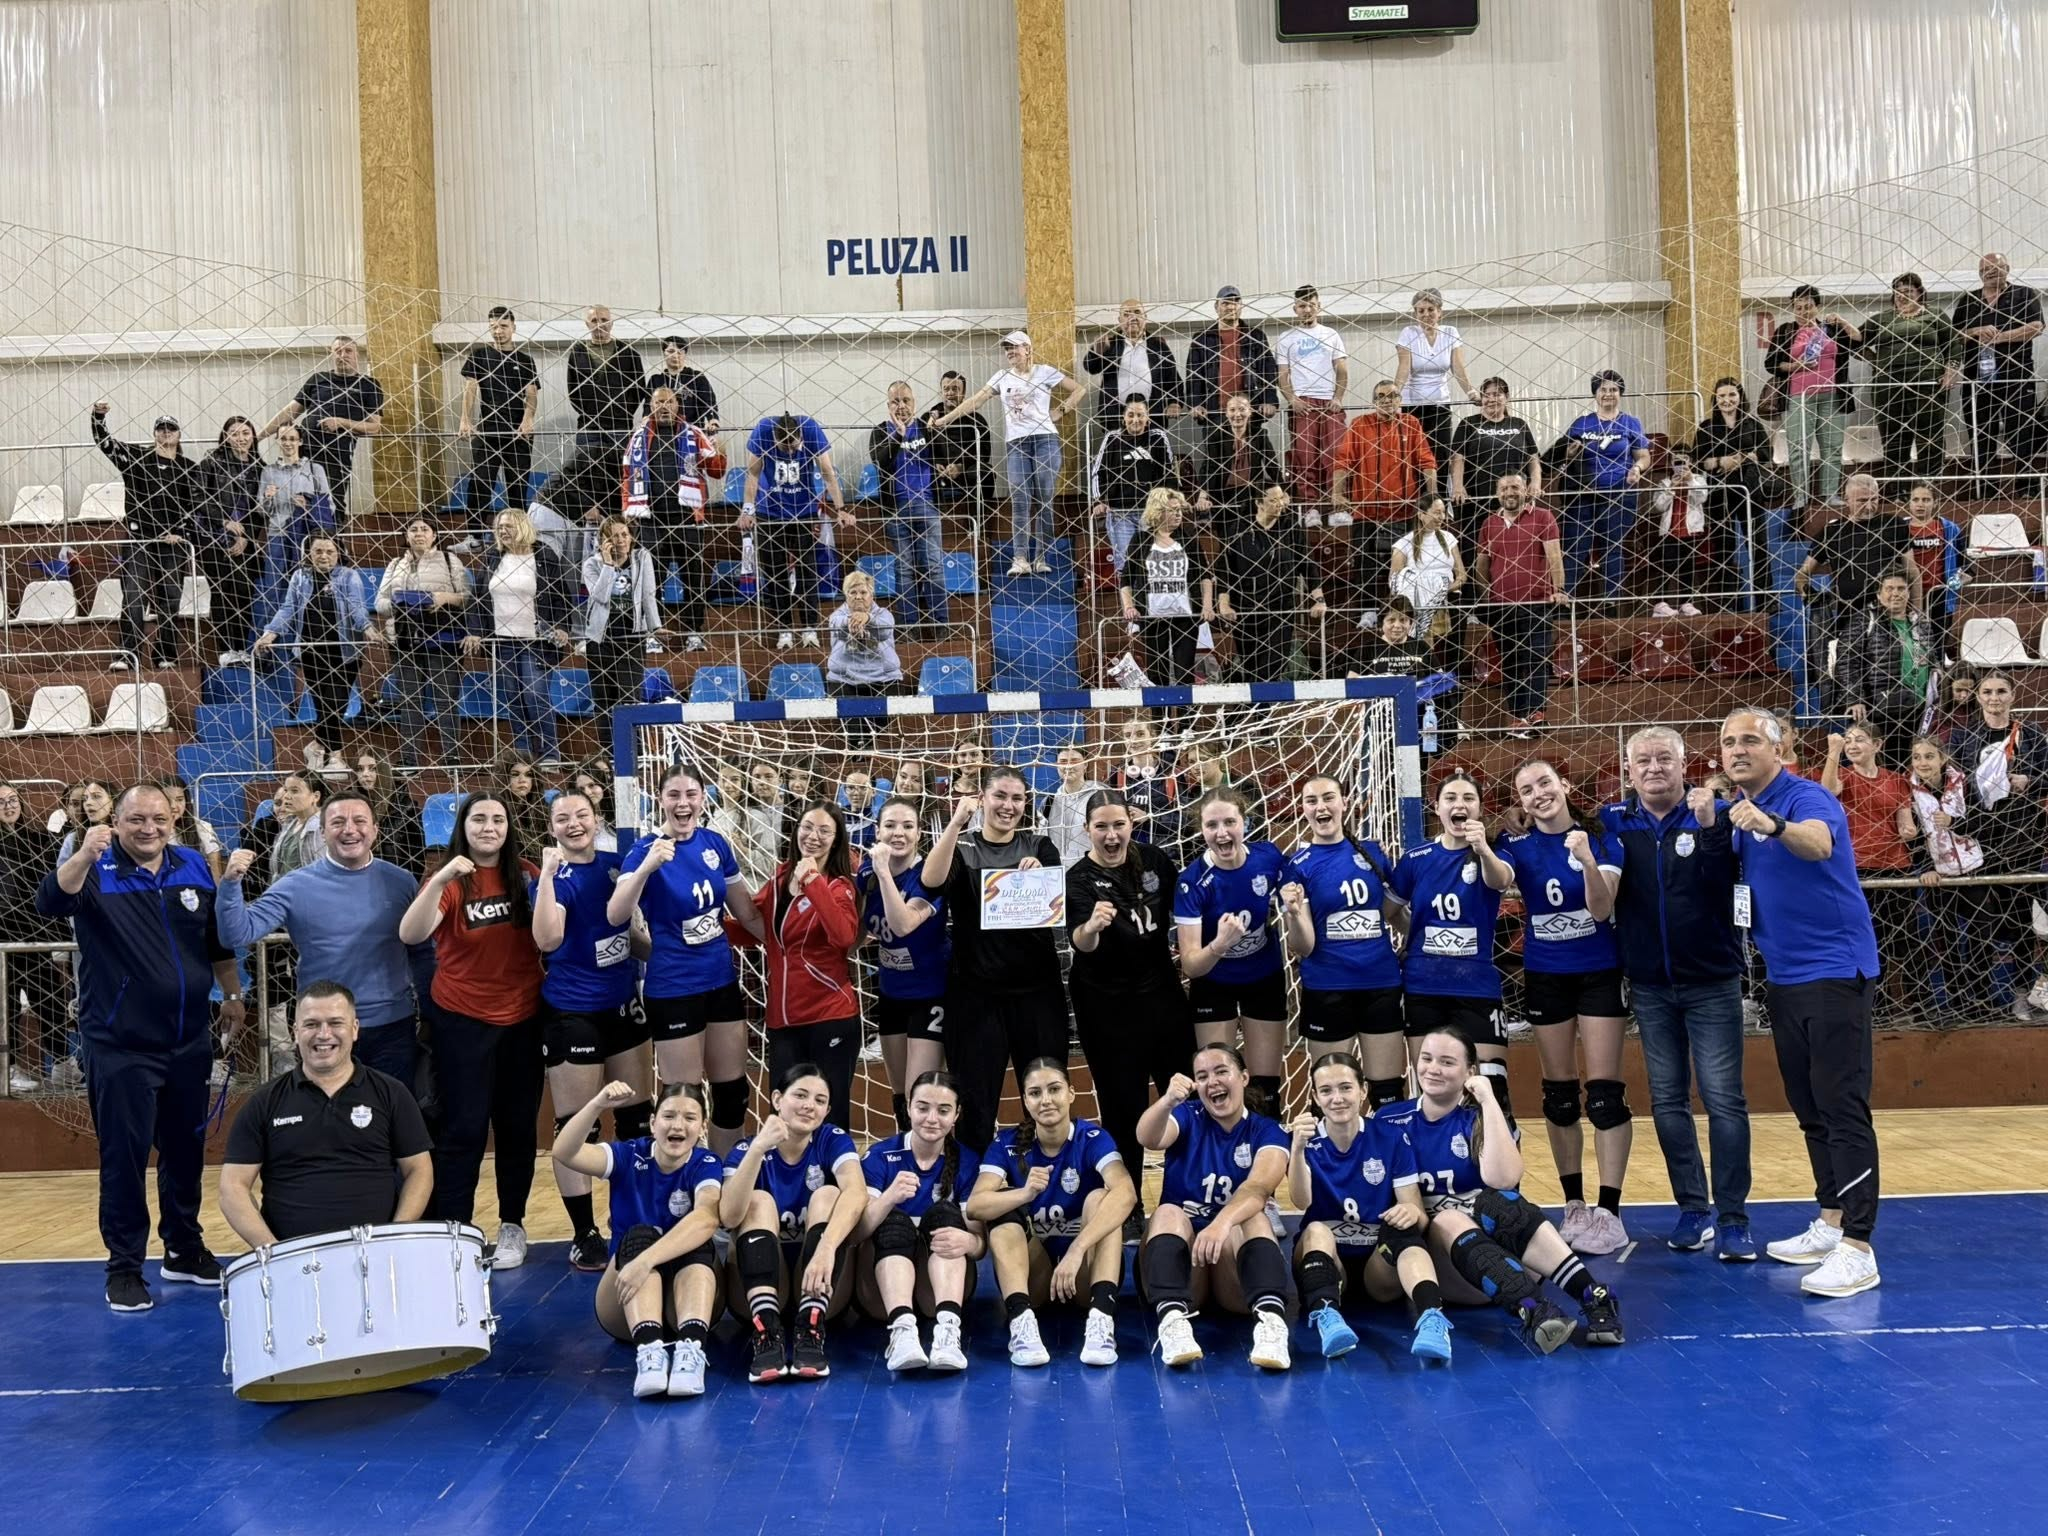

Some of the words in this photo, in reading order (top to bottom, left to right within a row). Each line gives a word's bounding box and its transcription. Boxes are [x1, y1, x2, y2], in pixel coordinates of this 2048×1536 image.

[1351, 8, 1406, 18] STRAMATEL
[826, 236, 940, 276] PELUZA
[949, 235, 969, 273] II
[1476, 427, 1522, 437] adidas
[1146, 559, 1186, 578] BSB
[1409, 847, 1433, 859] Kempa
[692, 879, 715, 910] 11
[1001, 887, 1048, 899] DIPLOMA
[1339, 878, 1369, 907] 10
[1546, 878, 1564, 907] 6
[1130, 904, 1158, 935] 12
[1431, 893, 1461, 921] 19
[869, 914, 894, 943] 28
[570, 1046, 596, 1054] Kempa
[273, 1115, 303, 1127] Kempa
[1201, 1172, 1233, 1206] 13
[1419, 1169, 1456, 1195] 27
[1343, 1197, 1361, 1224] 8
